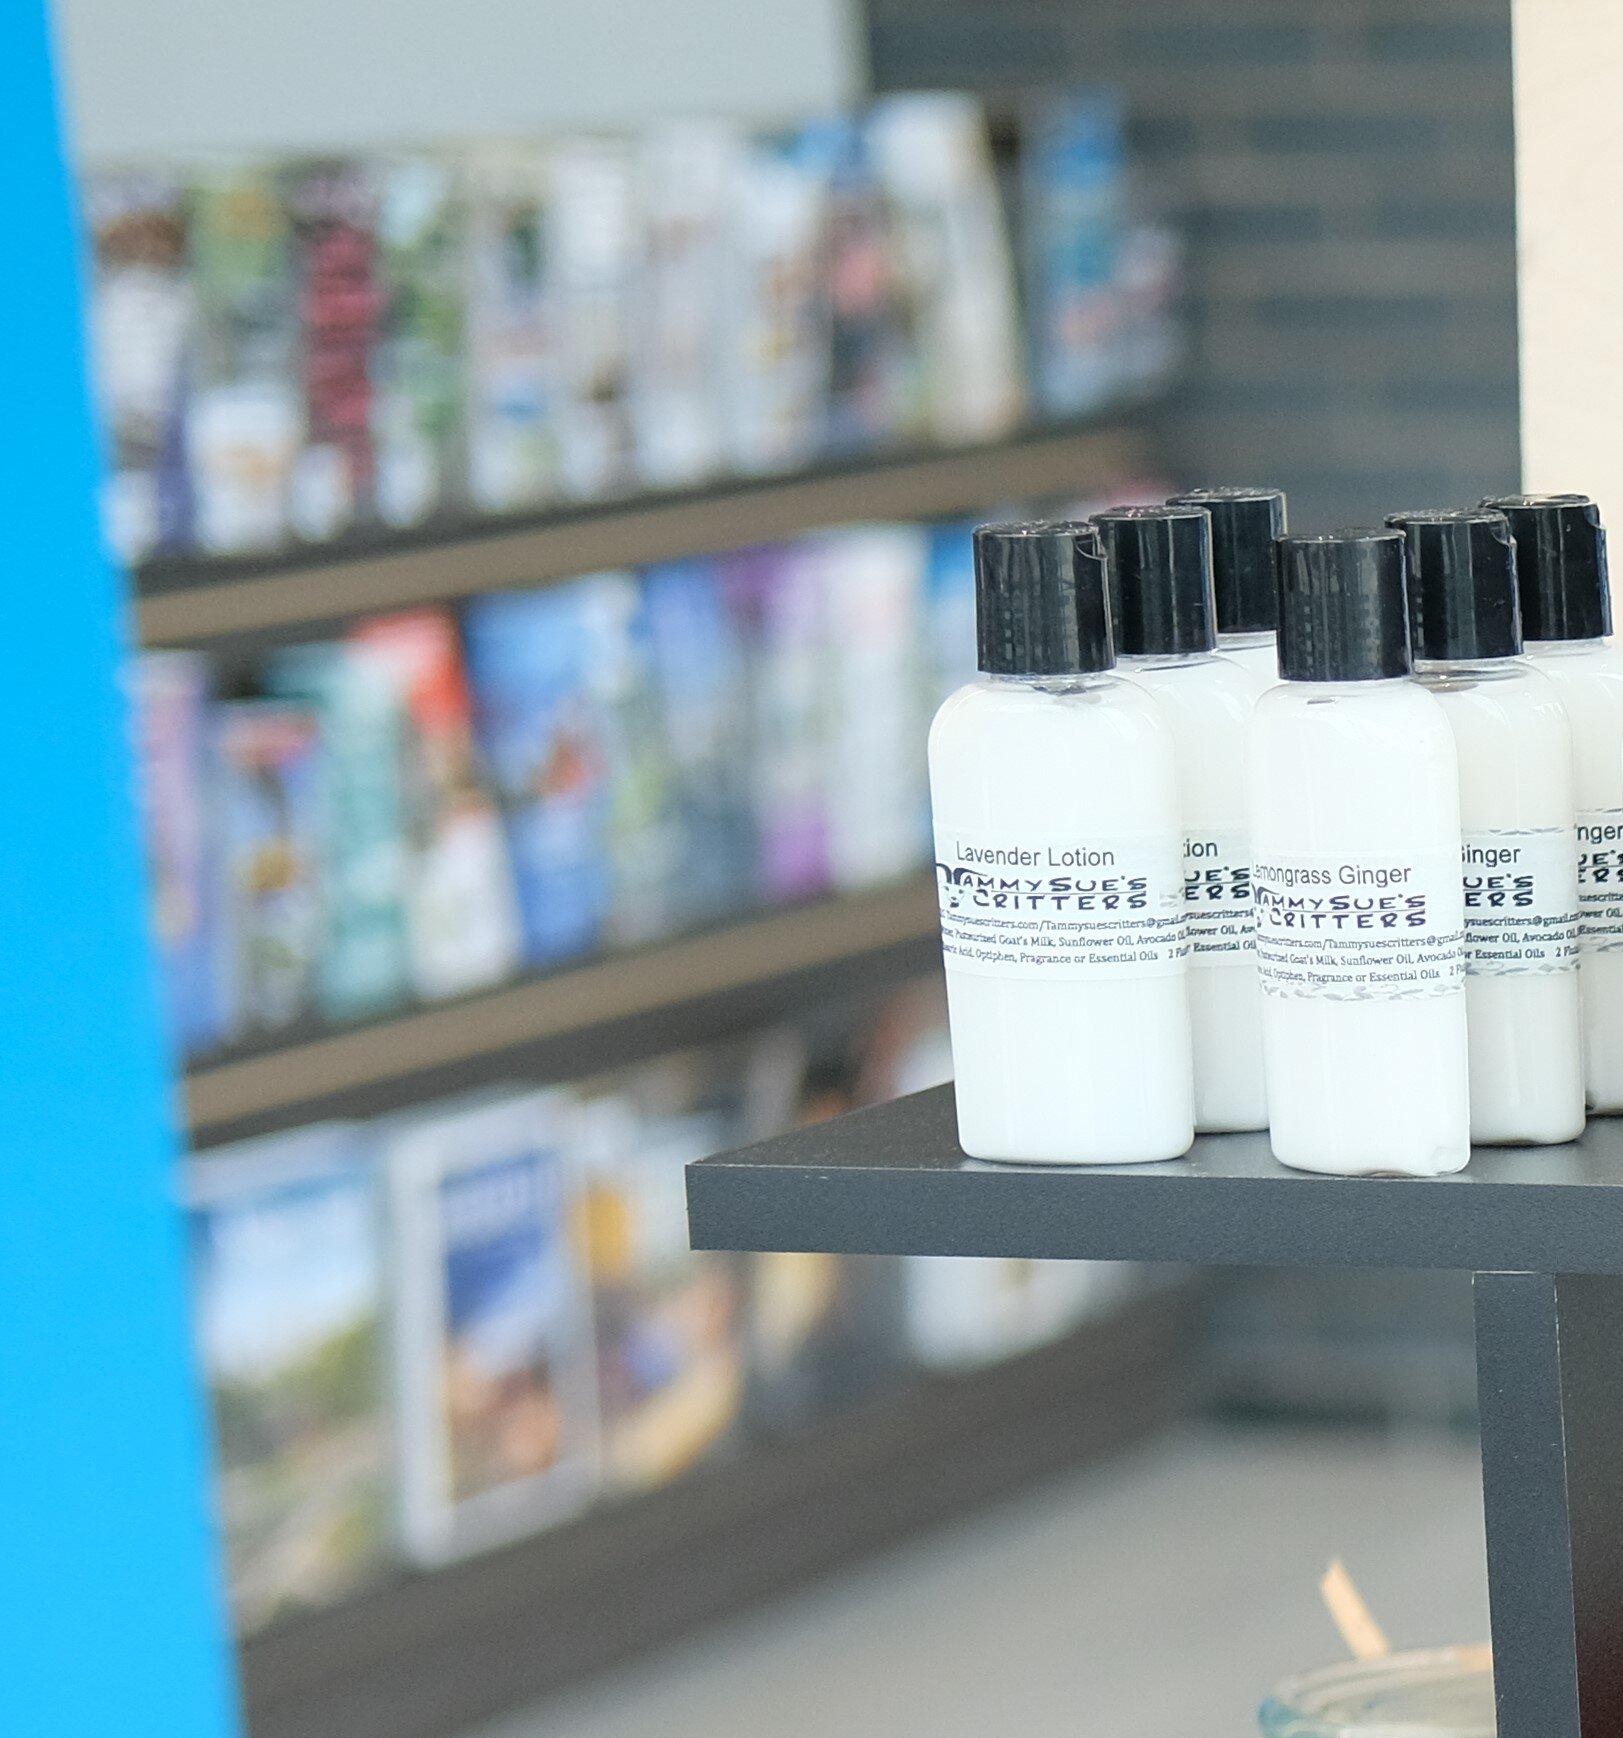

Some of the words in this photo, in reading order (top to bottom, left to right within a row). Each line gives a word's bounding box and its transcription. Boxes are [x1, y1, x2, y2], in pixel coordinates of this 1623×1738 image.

[955, 840, 1041, 867] Lavender
[1048, 847, 1116, 867] Lotion
[1338, 865, 1412, 888] Ginger
[973, 888, 1148, 911] CRITTERS
[1269, 906, 1427, 929] CRITTERS
[1058, 936, 1115, 948] Sunflower
[1074, 954, 1086, 964] or
[1089, 951, 1137, 964] Essential
[1340, 954, 1394, 967] Sunflower
[1369, 969, 1418, 983] Essential
